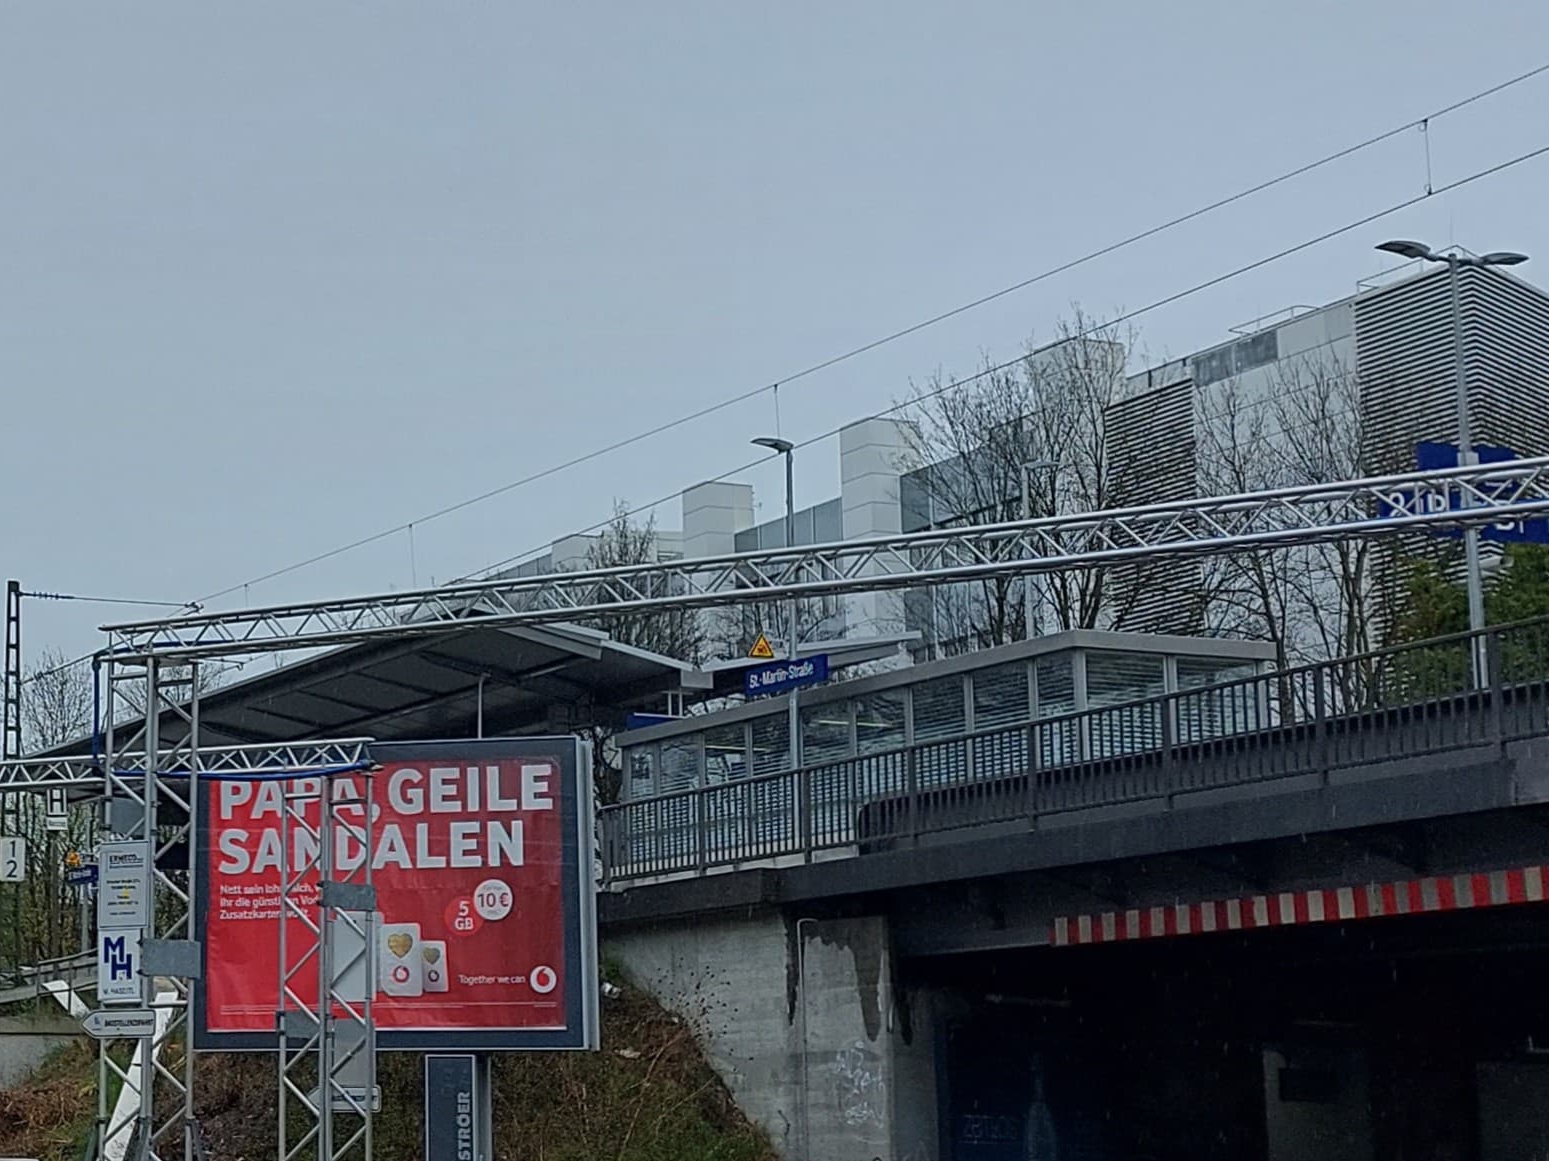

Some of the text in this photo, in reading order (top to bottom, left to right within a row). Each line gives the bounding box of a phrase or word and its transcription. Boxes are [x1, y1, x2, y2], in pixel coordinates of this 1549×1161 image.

[219, 764, 553, 823] PAPA, GEILE
[9, 840, 17, 858] 1
[218, 820, 525, 875] SANDALEN
[6, 860, 18, 878] 2
[477, 892, 510, 908] 10 €
[458, 901, 469, 917] 5
[454, 917, 474, 931] GB
[458, 974, 496, 986] Together
[510, 975, 526, 983] can
